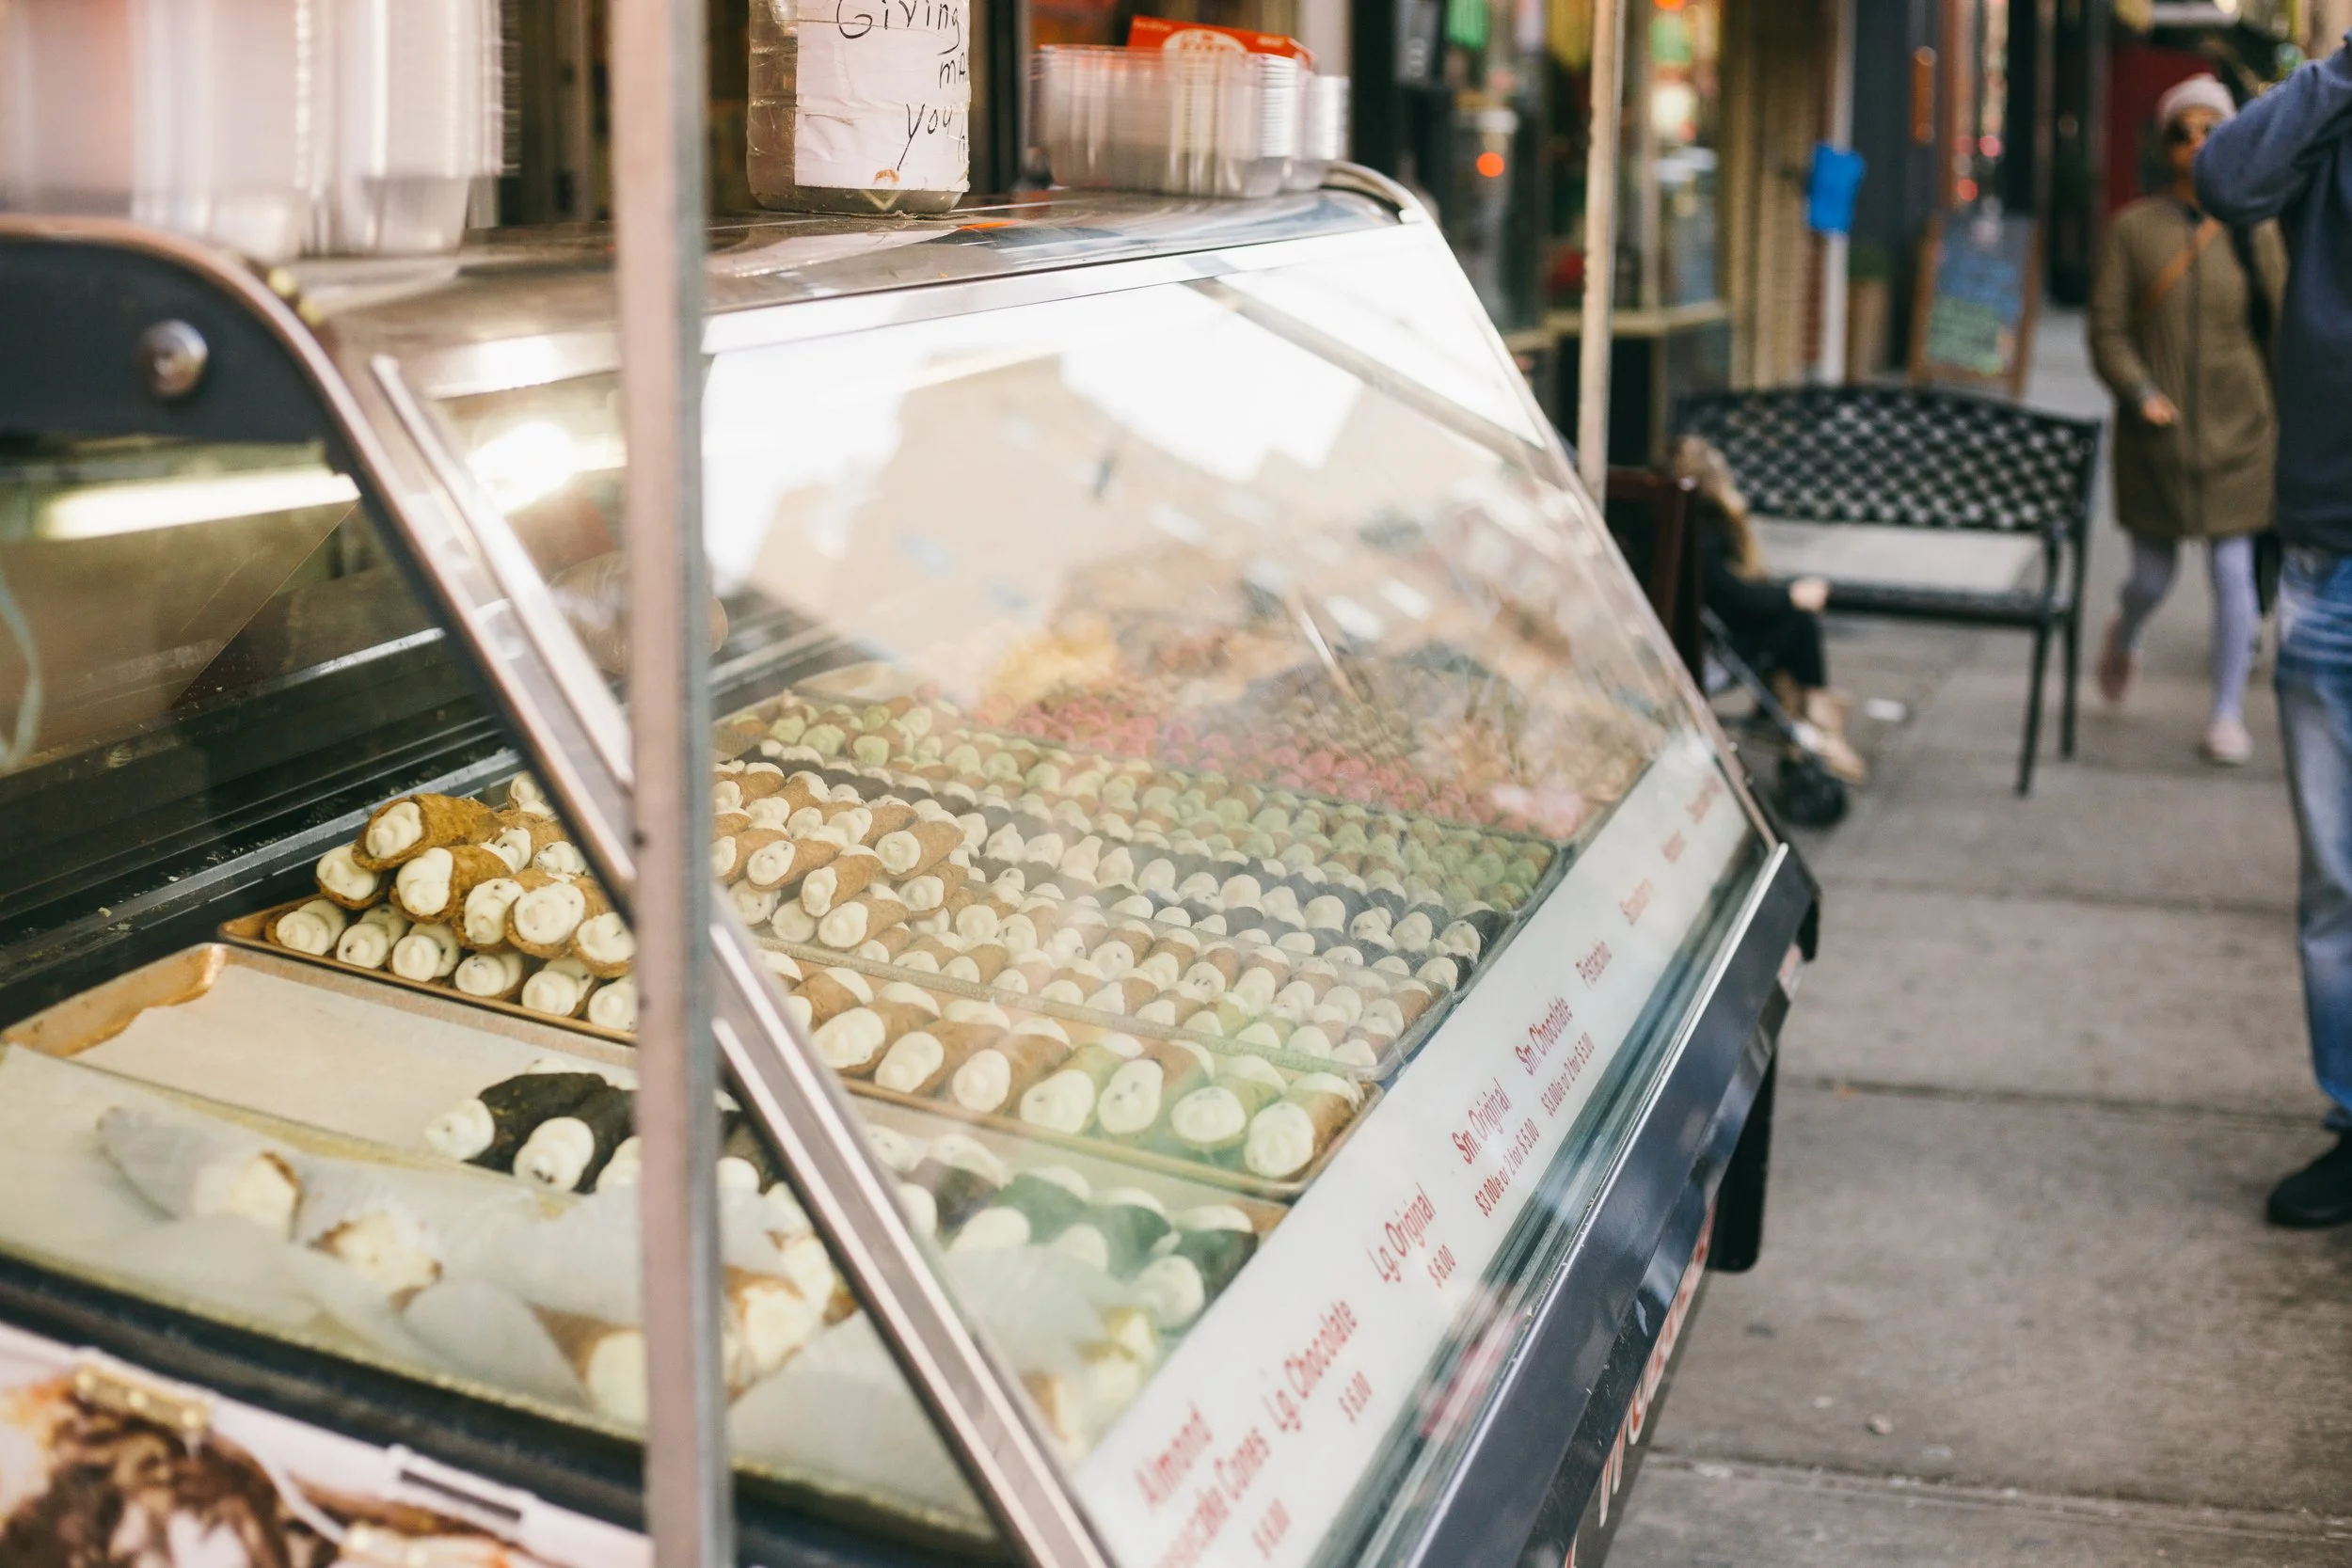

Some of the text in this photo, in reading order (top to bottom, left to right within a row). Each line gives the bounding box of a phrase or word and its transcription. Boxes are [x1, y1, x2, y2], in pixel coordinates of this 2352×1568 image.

[1529, 994, 1573, 1055] Chocolate
[1452, 1077, 1512, 1164] Sm. Original
[1499, 1166, 1511, 1185] or
[1503, 1154, 1516, 1175] 2
[1507, 1147, 1524, 1168] for
[1385, 1182, 1437, 1257] Original
[1284, 1300, 1358, 1400] Chocolate
